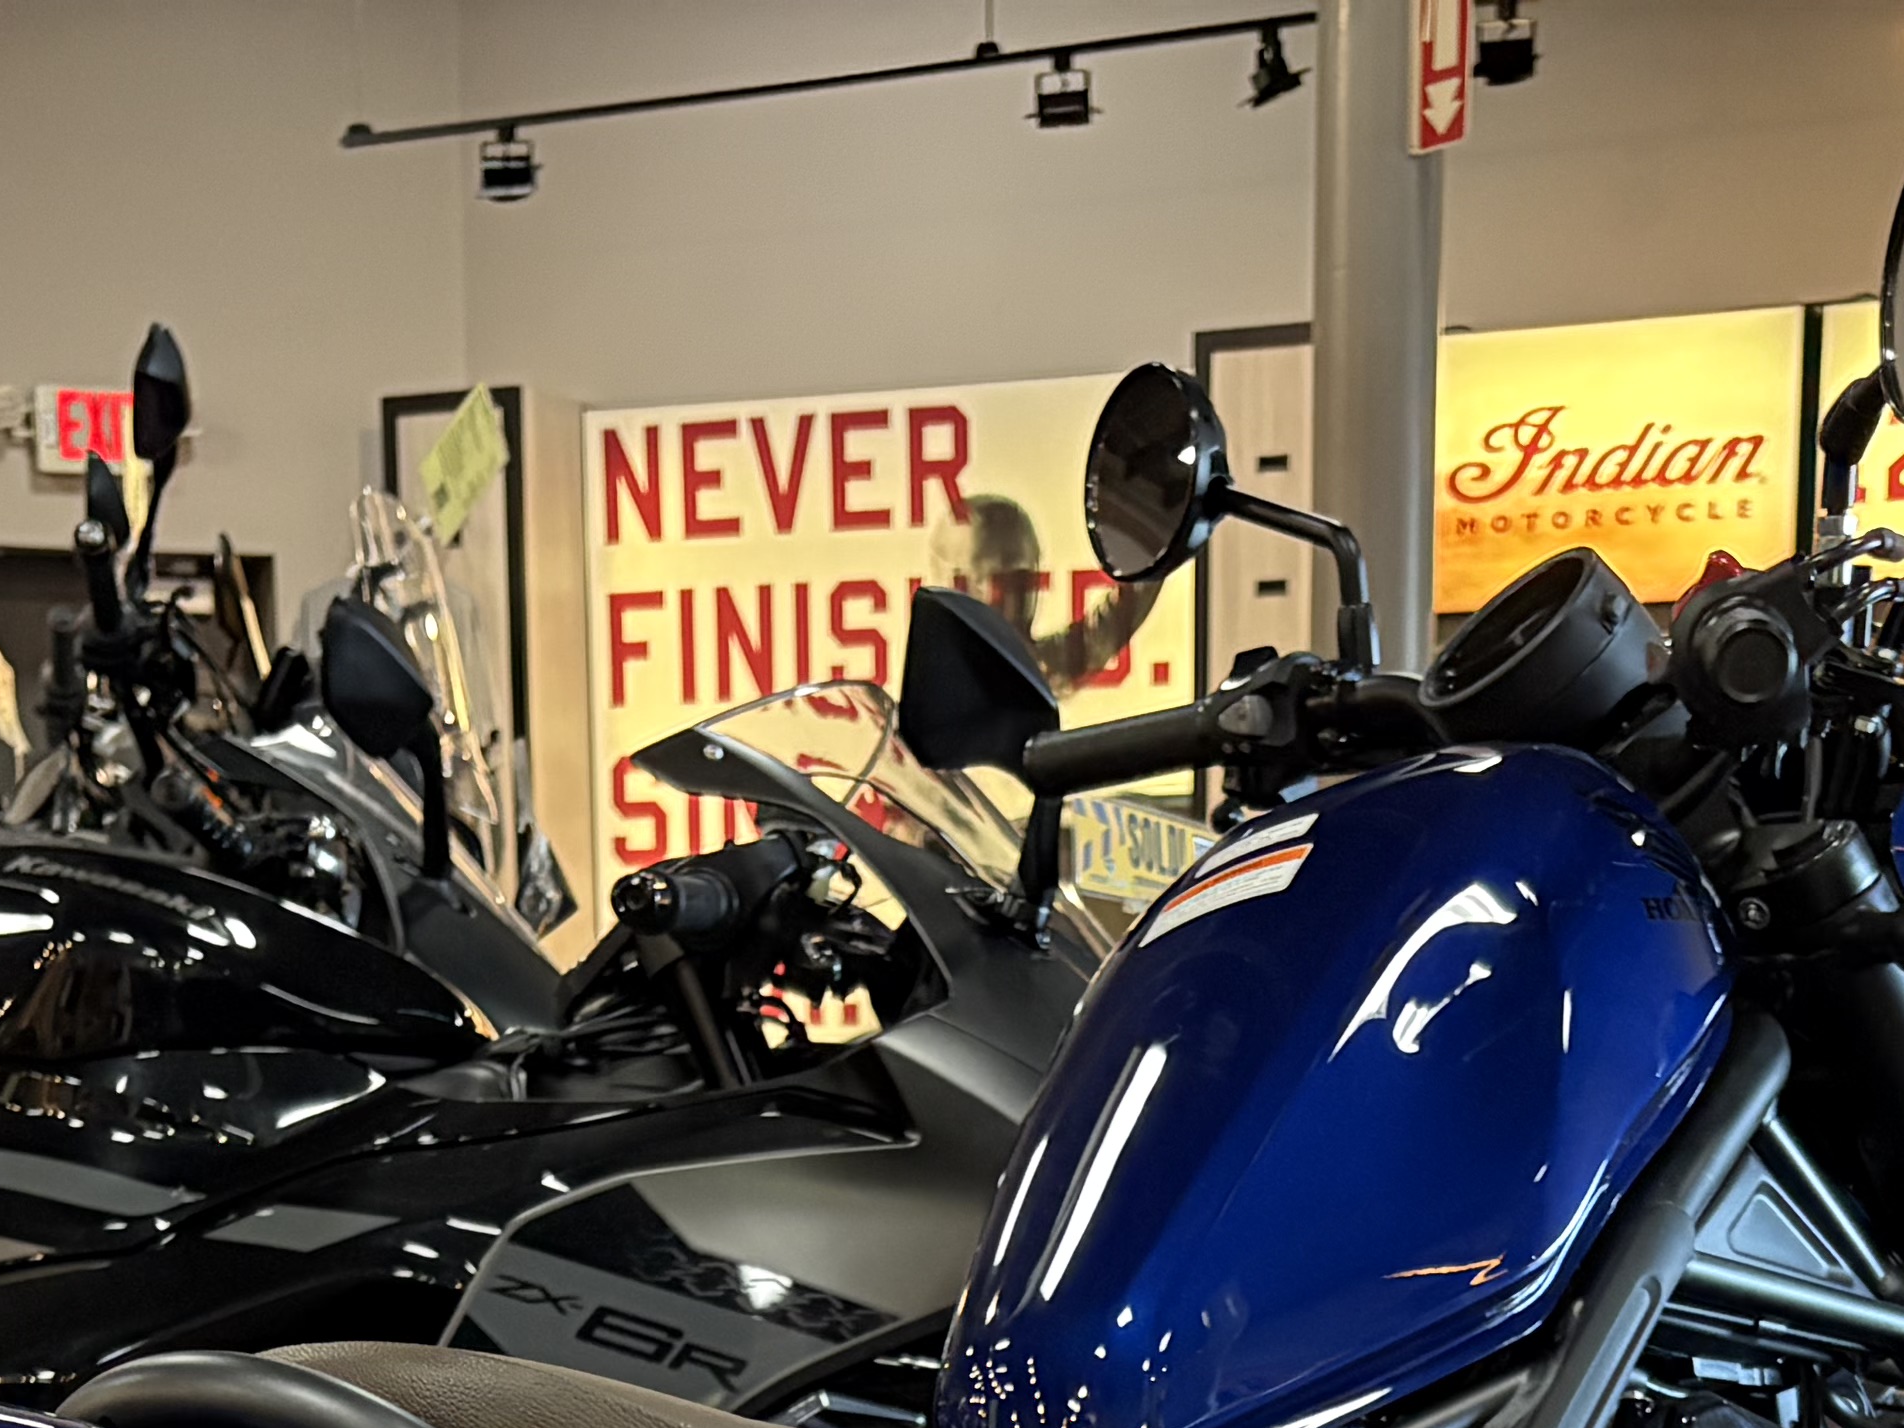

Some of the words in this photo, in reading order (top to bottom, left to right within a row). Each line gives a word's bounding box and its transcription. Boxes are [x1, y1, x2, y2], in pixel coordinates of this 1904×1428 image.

[603, 405, 970, 545] NEVER
[1446, 405, 1765, 504] Indian
[1455, 499, 1755, 535] MOTORCYCLE
[607, 569, 1173, 708] FINISD.
